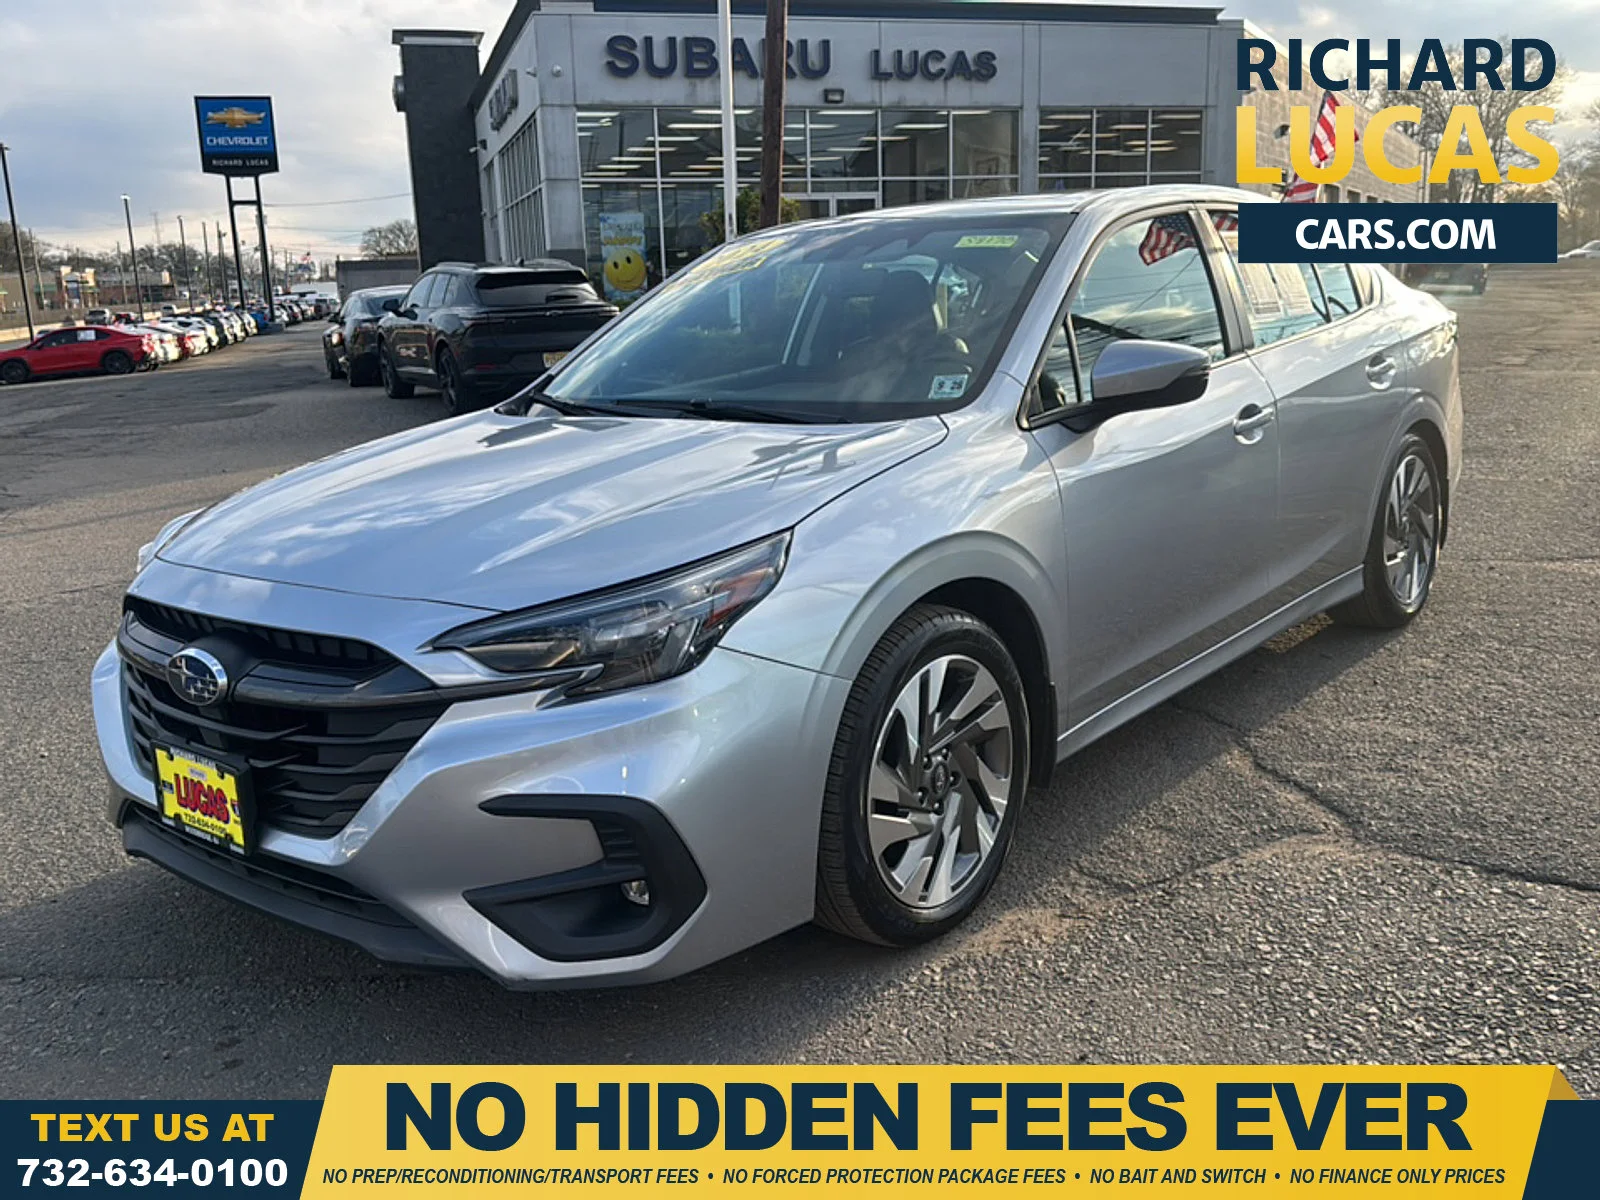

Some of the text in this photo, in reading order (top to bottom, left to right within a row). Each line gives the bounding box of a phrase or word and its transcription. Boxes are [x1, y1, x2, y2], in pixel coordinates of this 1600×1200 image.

[871, 48, 997, 82] LUCAS
[206, 136, 269, 146] CHEVROLET
[212, 159, 269, 167] RICHARD LUCAS
[173, 773, 230, 824] LUCAS
